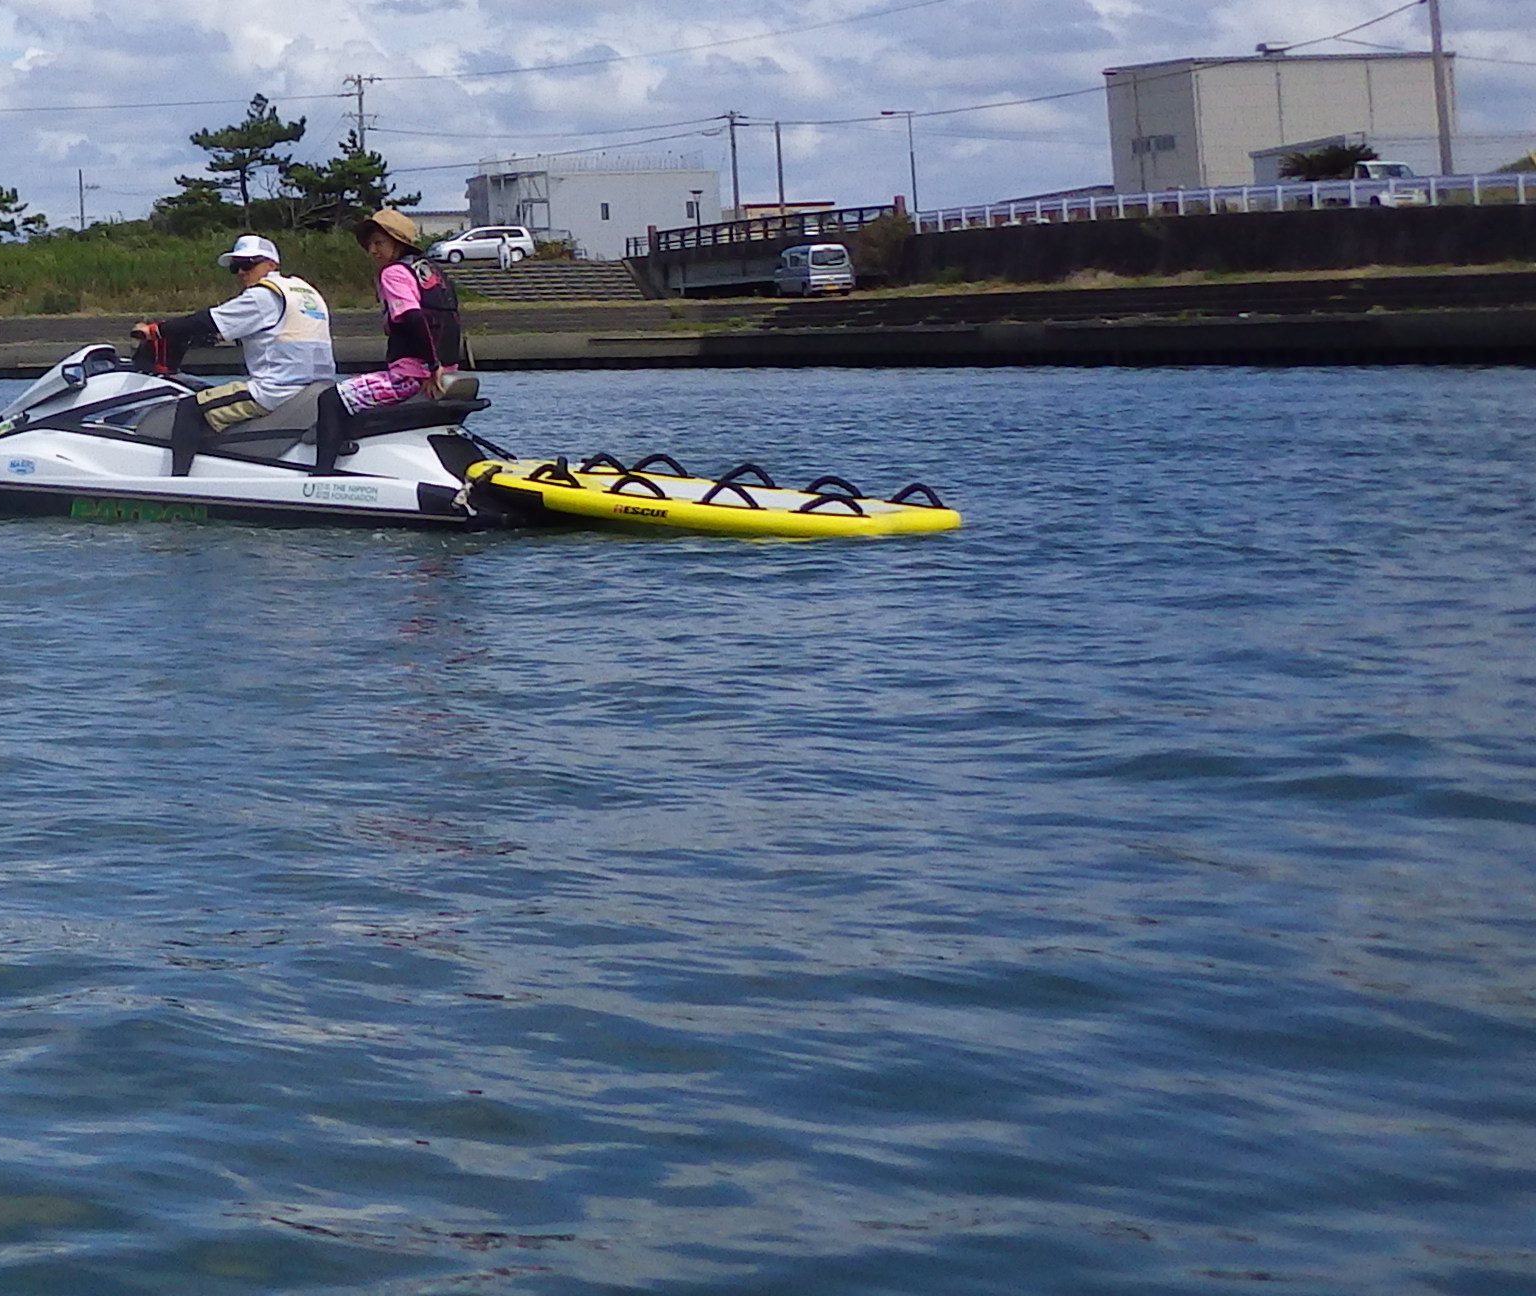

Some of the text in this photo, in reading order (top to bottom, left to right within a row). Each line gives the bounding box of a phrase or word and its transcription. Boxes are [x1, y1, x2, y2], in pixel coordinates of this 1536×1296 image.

[332, 484, 346, 492] THE
[348, 485, 378, 494] NIPPON
[613, 504, 669, 518] RESCUE
